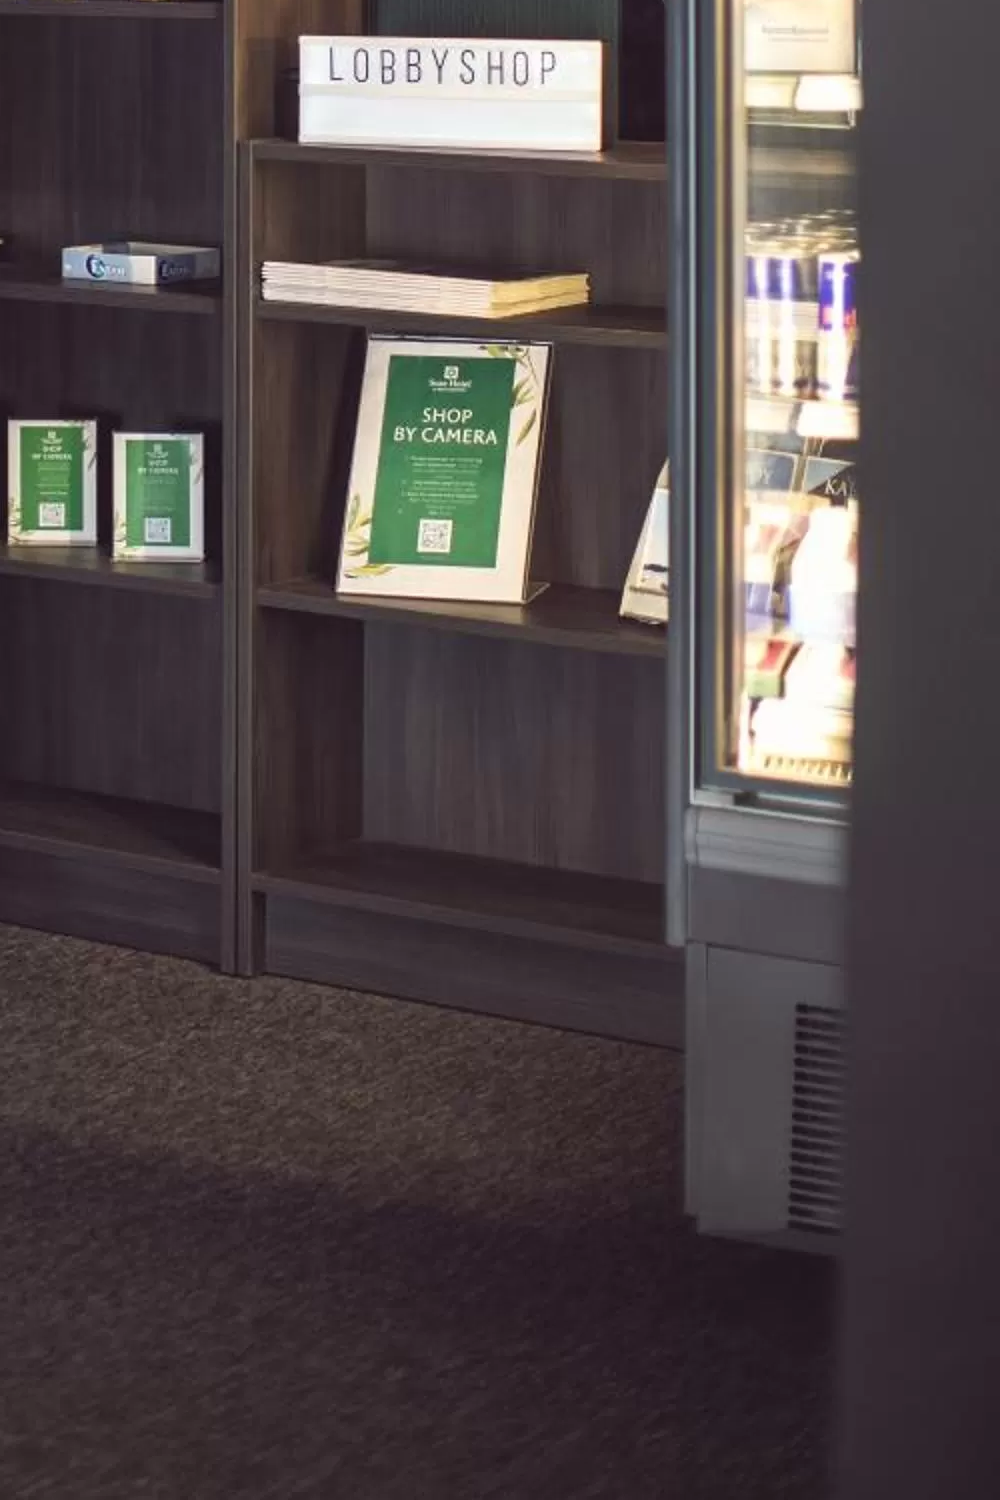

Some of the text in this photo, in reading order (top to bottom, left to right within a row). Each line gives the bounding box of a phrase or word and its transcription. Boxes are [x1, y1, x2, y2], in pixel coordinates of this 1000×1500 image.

[328, 46, 558, 87] LOBBYSHOP
[422, 407, 474, 424] SHOP
[393, 425, 498, 445] BY CAMERA
